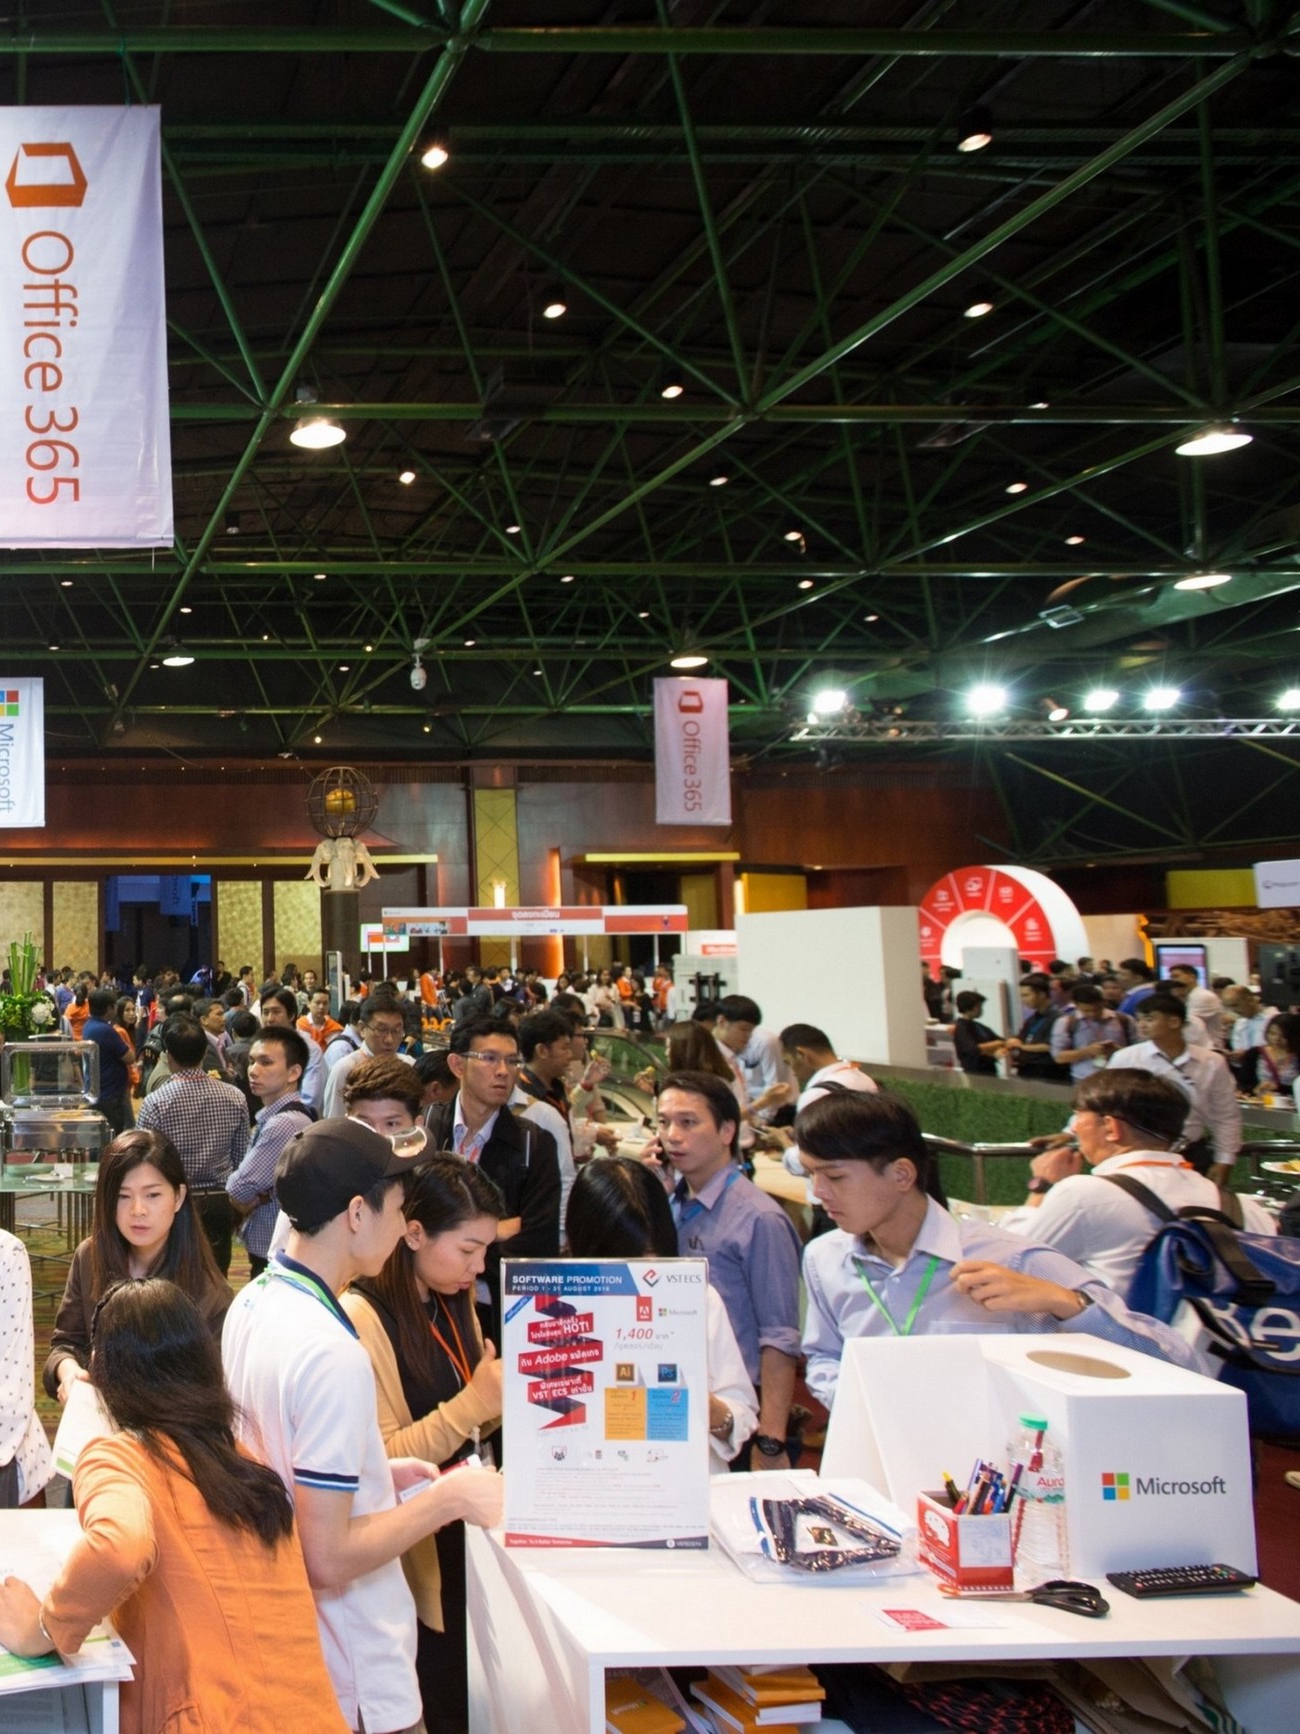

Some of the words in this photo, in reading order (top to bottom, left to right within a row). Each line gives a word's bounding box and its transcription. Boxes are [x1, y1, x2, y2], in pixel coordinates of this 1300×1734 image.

[21, 229, 79, 393] Office
[24, 405, 81, 505] 365
[682, 720, 702, 775] Office
[683, 779, 703, 812] 365
[512, 1275, 564, 1284] SOFTWARE
[566, 1275, 623, 1285] PROMOTION
[563, 1321, 590, 1335] HOT!
[614, 1328, 653, 1342] 1,400
[535, 1352, 569, 1365] Adobe
[619, 1367, 631, 1377] Ai
[661, 1367, 674, 1378] Ps
[532, 1390, 549, 1400] VST
[552, 1388, 568, 1398] ECS
[1135, 1475, 1227, 1496] Microsoft
